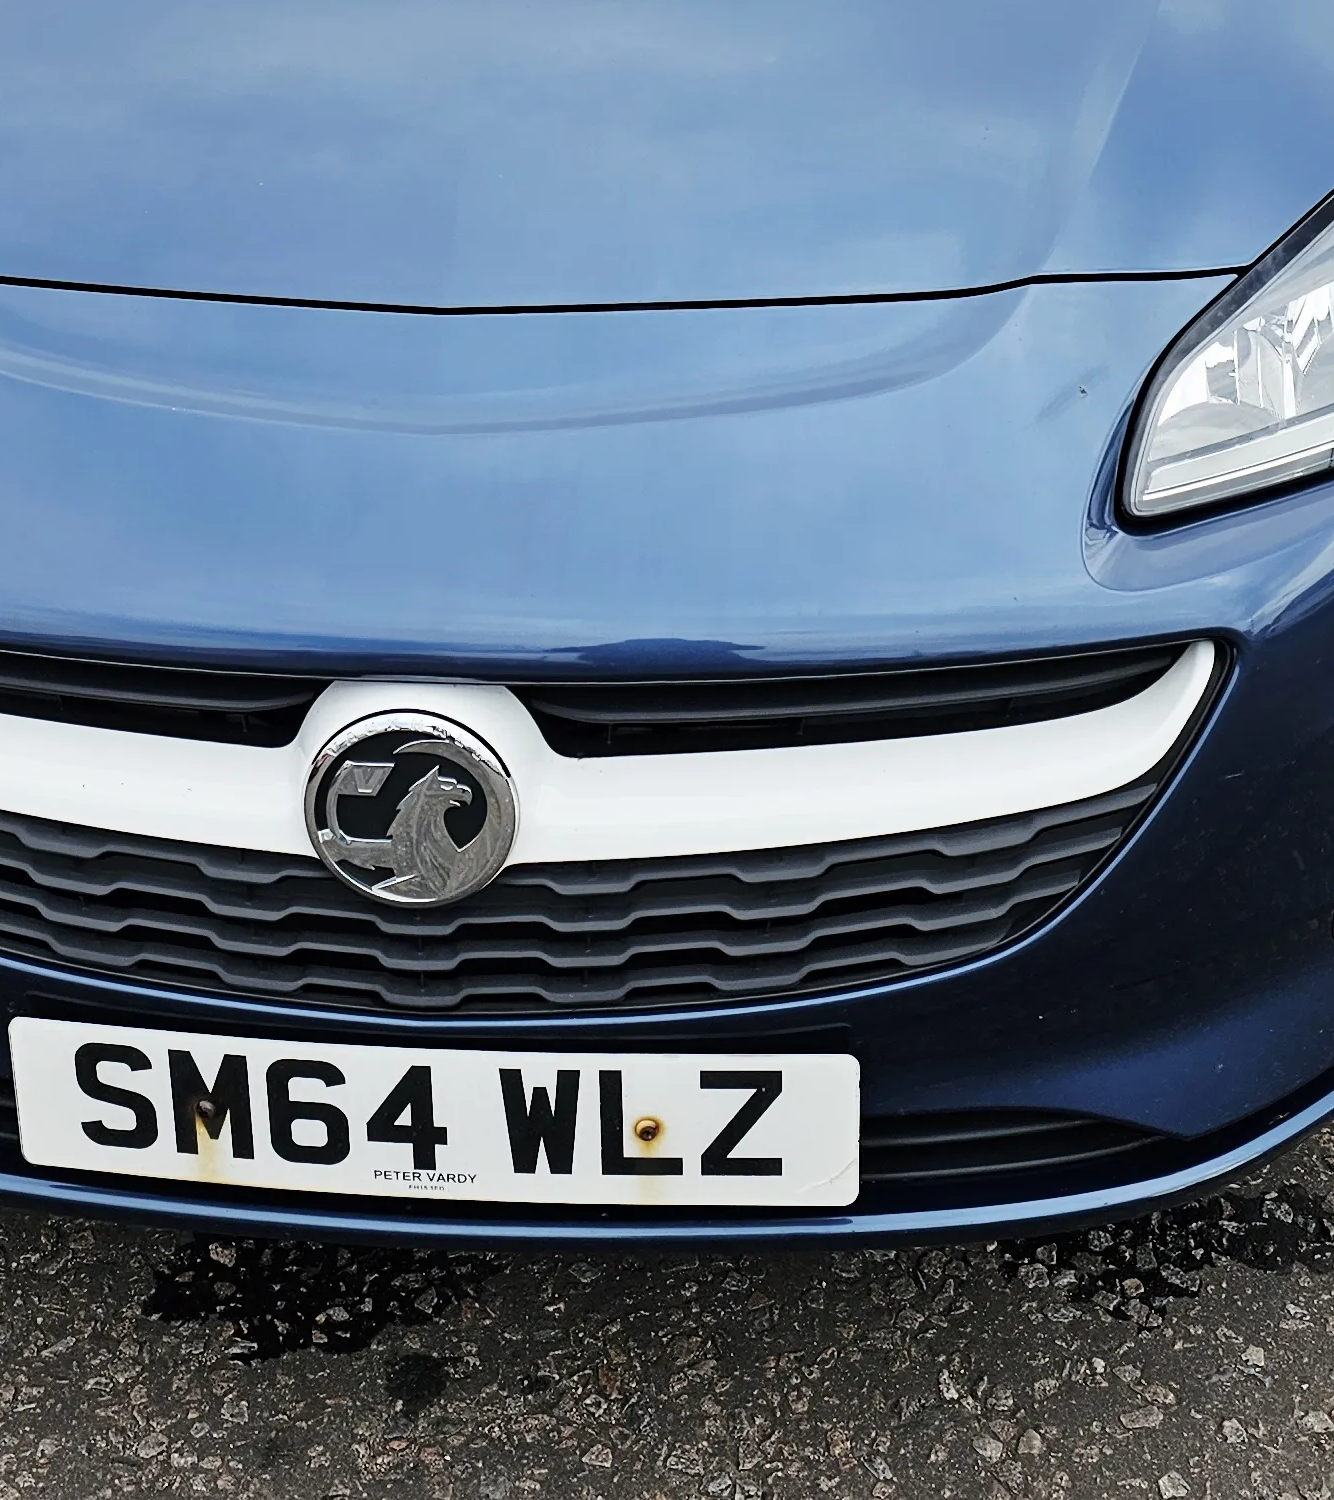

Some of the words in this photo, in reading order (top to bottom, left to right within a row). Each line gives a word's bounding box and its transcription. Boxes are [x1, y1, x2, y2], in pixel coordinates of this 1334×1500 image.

[75, 1043, 447, 1171] SM64
[499, 1068, 782, 1176] WLZ
[374, 1170, 422, 1182] PETER
[427, 1173, 477, 1184] VARDY
